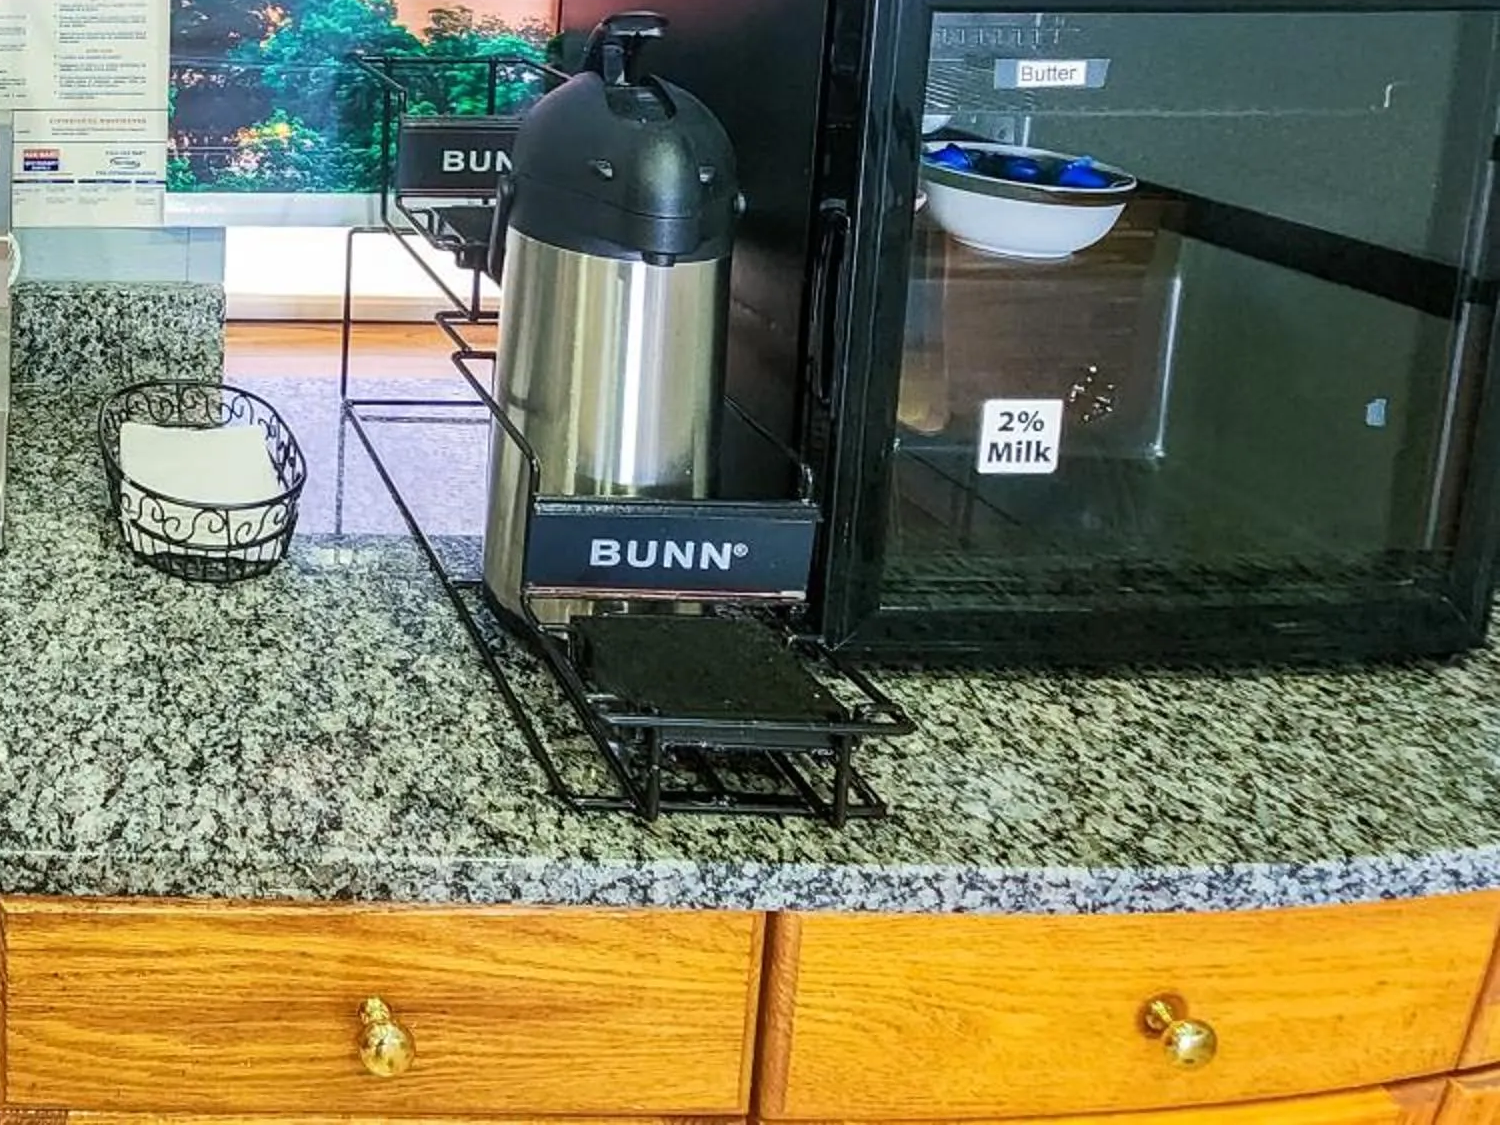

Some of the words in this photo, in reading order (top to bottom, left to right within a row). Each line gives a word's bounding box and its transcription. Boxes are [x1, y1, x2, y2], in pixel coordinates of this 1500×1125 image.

[1020, 66, 1077, 82] Butter
[442, 150, 513, 172] BUN
[997, 410, 1045, 433] 2%
[987, 440, 1052, 463] Milk
